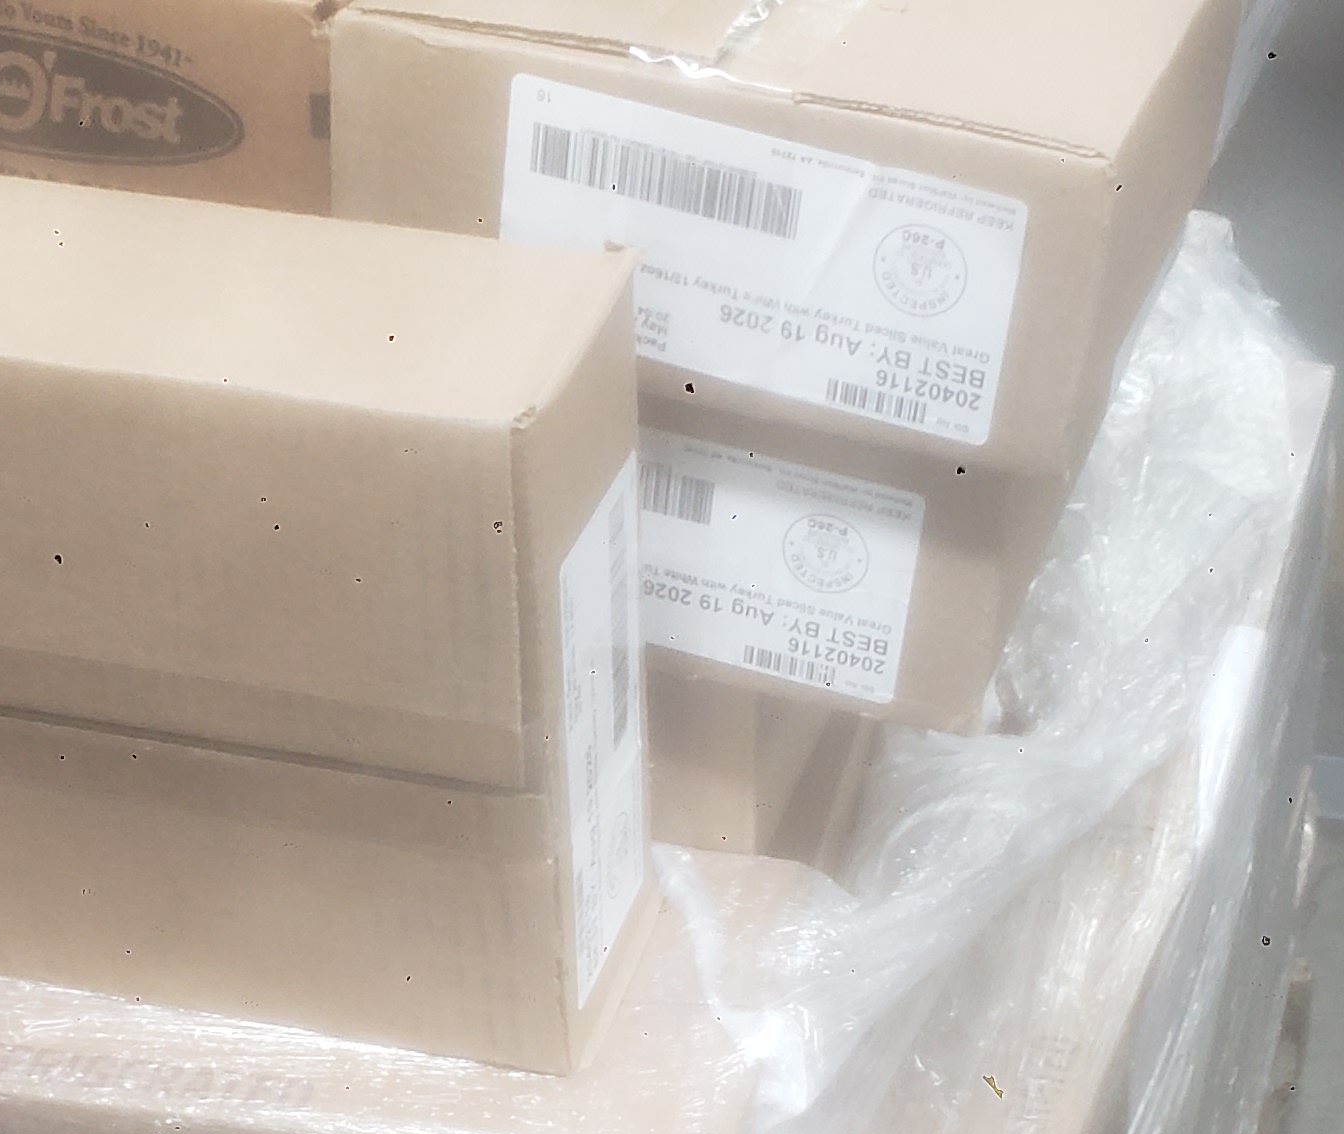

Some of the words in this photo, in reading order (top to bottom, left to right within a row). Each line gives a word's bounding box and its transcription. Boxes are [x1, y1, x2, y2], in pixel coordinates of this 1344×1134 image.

[535, 88, 554, 103] 16
[880, 270, 949, 309] INSPECTED
[717, 303, 774, 333] 2026
[813, 307, 863, 331] Turkey
[778, 319, 807, 343] 19
[812, 324, 863, 356] Aug
[864, 323, 907, 343] Sliced
[909, 334, 949, 353] Value
[952, 344, 991, 364] Great
[867, 343, 912, 369] BY:
[919, 356, 985, 388] BEST
[875, 369, 980, 410] 20402116
[790, 554, 853, 588] INSPECTED
[641, 579, 693, 606] 2026
[698, 594, 724, 613] 19
[729, 584, 773, 604] Turkey
[729, 598, 775, 625] Aug
[776, 598, 815, 615] Sliced
[819, 609, 854, 625] Value
[781, 615, 820, 638] BY:
[857, 618, 892, 634] Great
[827, 628, 888, 654] BEST
[788, 638, 884, 673] 20402116
